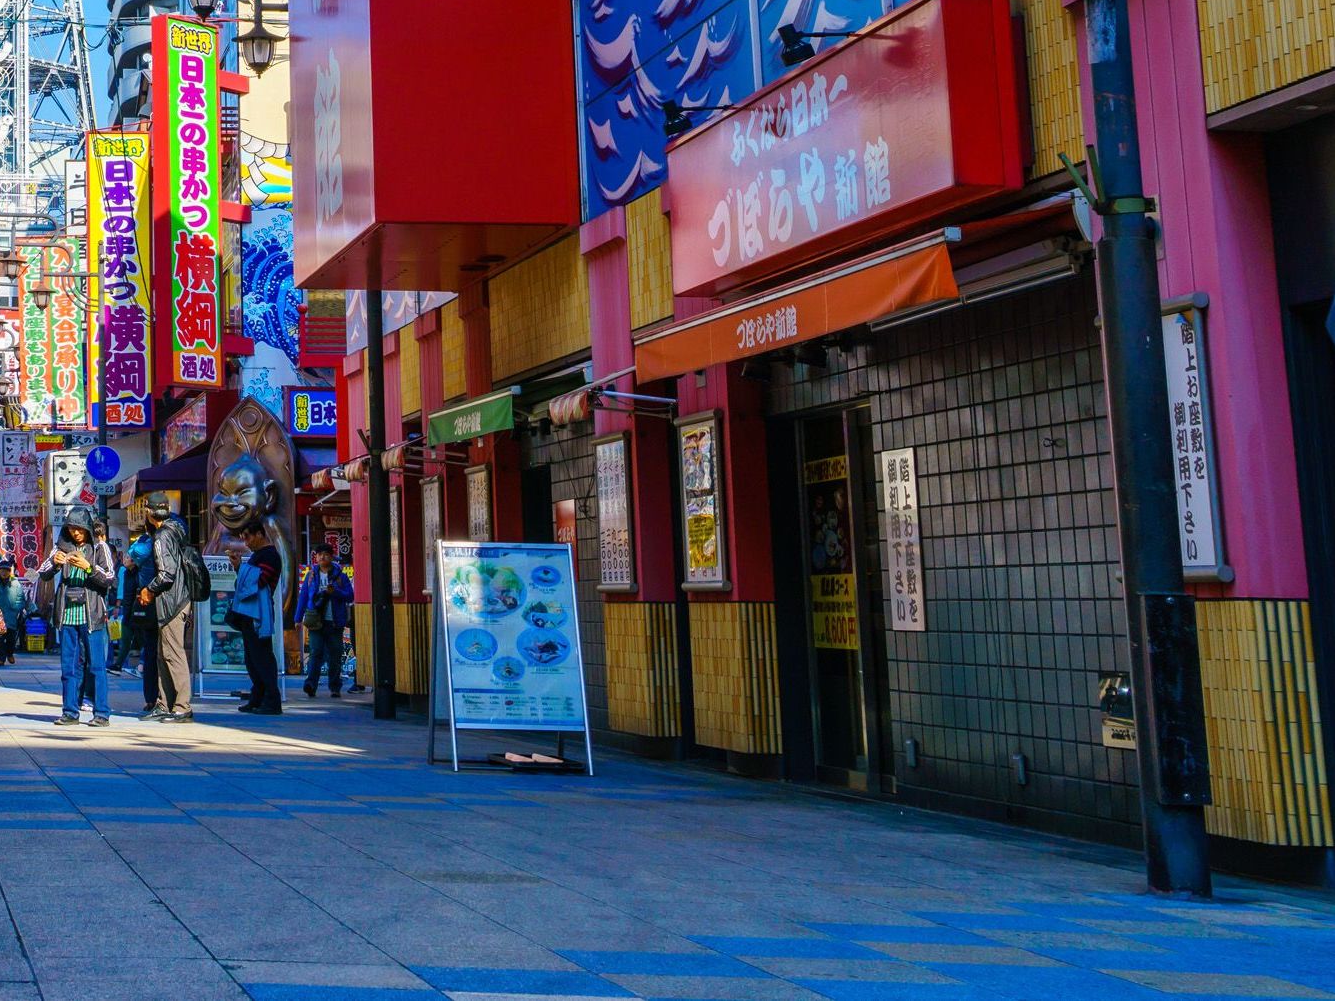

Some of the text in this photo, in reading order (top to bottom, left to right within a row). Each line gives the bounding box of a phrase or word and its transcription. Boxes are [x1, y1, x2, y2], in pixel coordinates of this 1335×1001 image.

[170, 26, 212, 55] 新世界
[94, 138, 145, 158] 新世界
[179, 55, 209, 230] 日本一の串かつ
[730, 71, 848, 168] ふぐなら日本一
[103, 160, 138, 300] 日本一の串かつ
[708, 135, 892, 268] づぼらや新館
[174, 232, 217, 350] 横綱
[736, 304, 798, 351] づぼらや新館
[95, 305, 147, 400] 横綱
[180, 354, 216, 381] 酒処
[1180, 322, 1205, 480] 階上お座敷を
[294, 394, 309, 432] 新世界
[310, 403, 336, 425] 日本
[1174, 401, 1199, 561] 御利用下さい
[886, 458, 907, 622] 御利用下さい
[899, 456, 918, 623] 階上お座敷を
